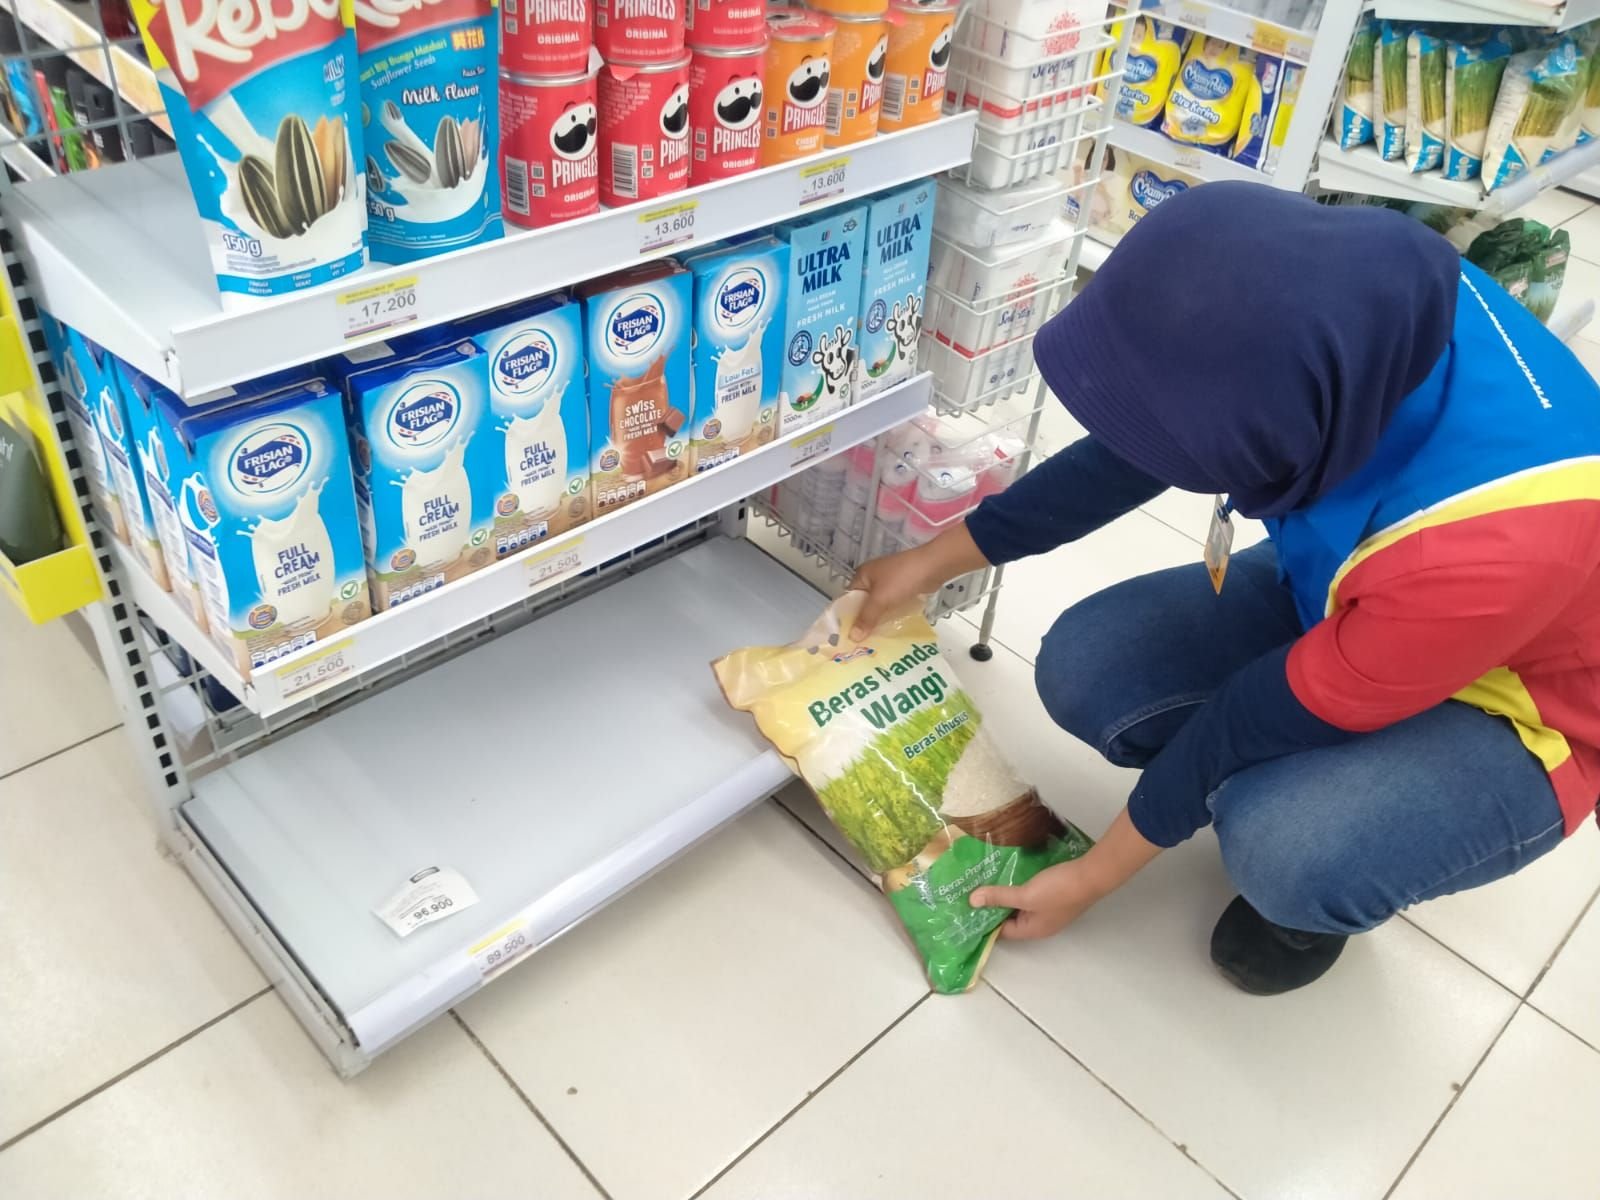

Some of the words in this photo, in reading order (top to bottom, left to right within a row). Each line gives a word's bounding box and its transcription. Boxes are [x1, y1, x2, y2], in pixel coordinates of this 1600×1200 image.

[524, 0, 586, 26] PRINGLES
[728, 6, 761, 19] ORIGINAL
[537, 32, 580, 44] ORIGINAL
[625, 28, 668, 39] ORIGINAL
[370, 64, 412, 89] Sunflower
[414, 54, 436, 69] Seeds
[402, 85, 440, 105] Milk
[445, 82, 480, 100] Flavor
[1189, 101, 1220, 124] Kering
[713, 126, 762, 154] PRINGLES
[722, 158, 756, 170] ORIGINAL
[811, 169, 846, 191] 13.600
[563, 187, 596, 203] ORIGINAL
[385, 206, 395, 222] g
[655, 213, 695, 237] 13.600
[877, 213, 921, 248] ULTRA
[223, 233, 248, 253] 150
[248, 239, 263, 257] g
[880, 234, 914, 265] MILK
[797, 242, 850, 276] ULTRA
[802, 263, 842, 295] MILK
[898, 272, 915, 286] MILK
[361, 292, 416, 318] 17.200
[724, 287, 755, 304] FRISIAN
[617, 315, 653, 333] FRISIAN
[796, 312, 823, 329] FRESH
[824, 302, 846, 316] MILK
[505, 350, 544, 371] FRISIAN
[721, 390, 741, 404] FRESH
[741, 384, 757, 395] MILK
[401, 401, 445, 423] FRISIAN
[619, 408, 662, 430] CHOCOLATE
[625, 399, 655, 417] SWISS
[623, 430, 643, 441] FRESH
[643, 425, 658, 436] MILK
[243, 445, 293, 469] FRISIAN
[520, 450, 557, 472] CREAM
[524, 440, 549, 459] FULL
[521, 475, 540, 488] FRESH
[541, 468, 556, 480] MILK
[419, 502, 460, 527] CREAM
[424, 494, 451, 514] FULL
[419, 528, 441, 543] FRESH
[441, 521, 459, 533] MILK
[274, 551, 320, 579] CREAM
[277, 542, 310, 565] FULL
[539, 553, 579, 577] 21.500
[278, 580, 302, 597] FRESH
[303, 573, 321, 586] MILK
[294, 657, 344, 687] 21.500
[807, 675, 880, 728] Beras
[860, 666, 949, 730] Wangi
[903, 730, 937, 759] Beras
[935, 711, 969, 738] Khusus
[964, 848, 1001, 878] Premium
[413, 898, 454, 920] 96.900
